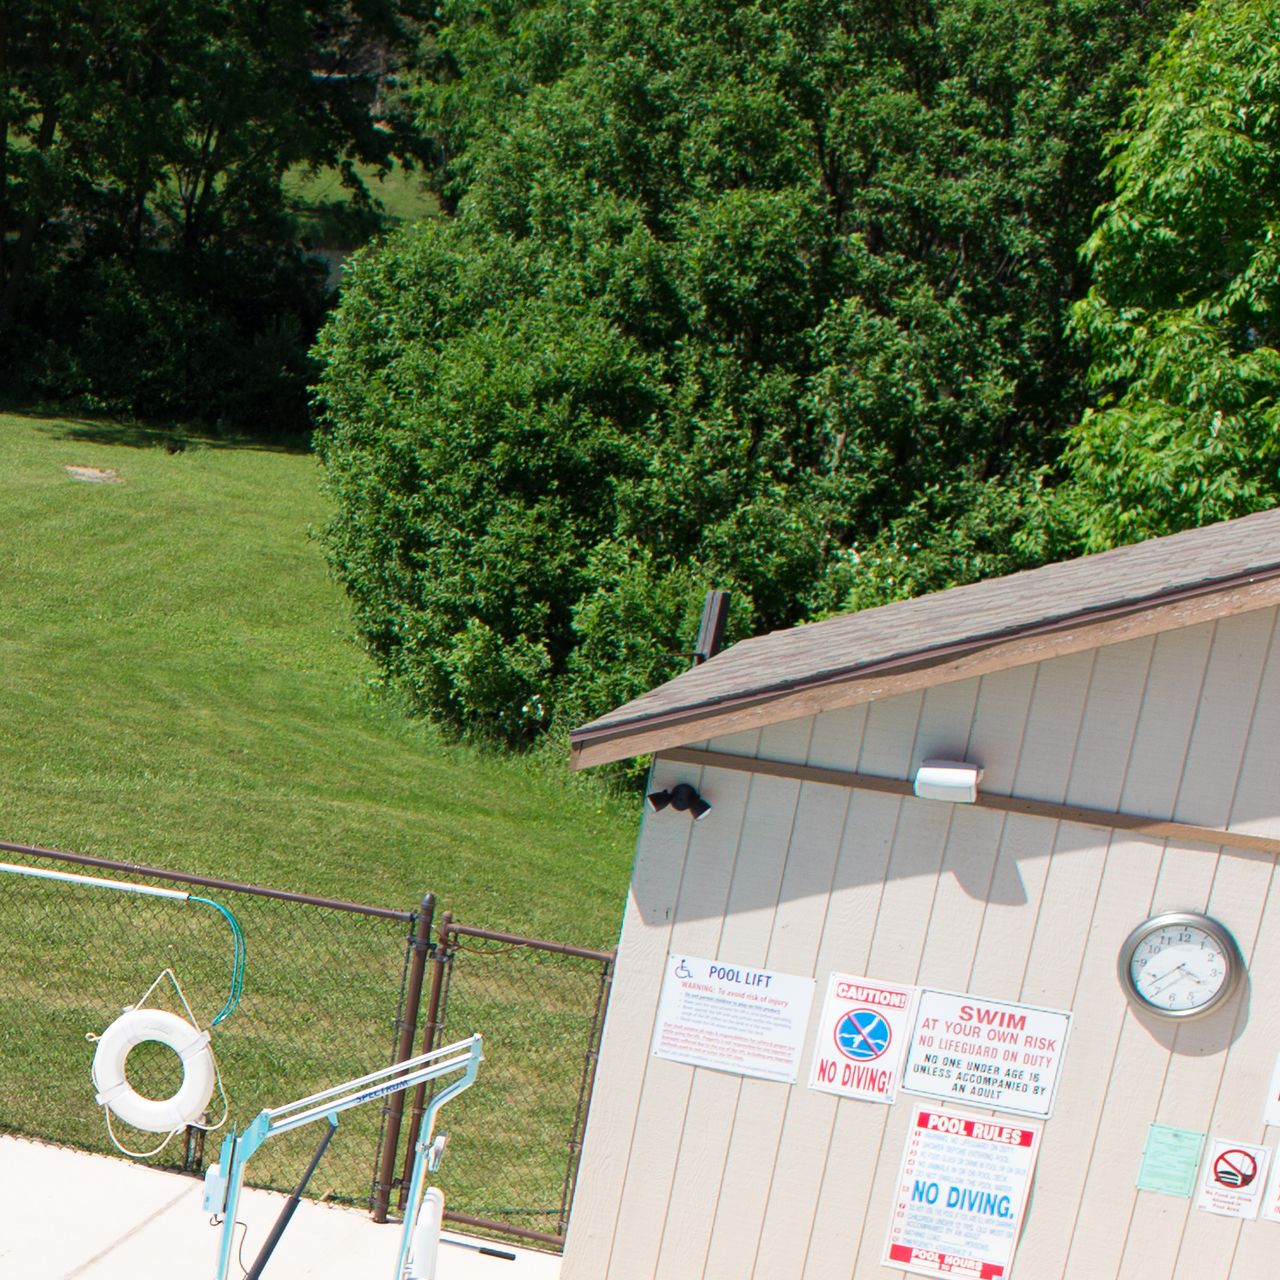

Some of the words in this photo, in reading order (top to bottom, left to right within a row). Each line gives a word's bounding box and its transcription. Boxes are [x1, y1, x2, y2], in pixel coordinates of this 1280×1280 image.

[1160, 936, 1172, 945] 11
[1178, 933, 1191, 942] 12
[1148, 945, 1161, 954] 10
[1208, 953, 1214, 961] 2
[1140, 959, 1147, 967] 9
[1210, 968, 1217, 977] 3
[708, 965, 742, 983] POOL
[745, 971, 773, 988] LIFT
[717, 986, 726, 996] To
[726, 989, 744, 1000] avoid
[745, 991, 758, 1002] risk
[759, 994, 768, 1003] of
[837, 983, 907, 1008] CAUTION!
[1169, 993, 1176, 1001] 6
[959, 1005, 1027, 1031] SWIM
[922, 1017, 939, 1031] AT
[944, 1020, 981, 1039] YOUR
[987, 1028, 1018, 1046] OWN
[1024, 1035, 1056, 1052] RISK
[919, 1035, 934, 1048] NO
[938, 1038, 998, 1059] LIFEGUARD
[1003, 1049, 1017, 1062] ON
[1023, 1053, 1052, 1069] DUTY
[817, 1059, 836, 1083] NO
[841, 1063, 892, 1095] DIVING!
[924, 1054, 938, 1065] NO
[942, 1056, 962, 1069] ONE
[967, 1060, 1000, 1076] UNDER
[1004, 1067, 1025, 1080] AGE
[913, 1063, 952, 1080] UNLESS
[955, 1070, 1028, 1094] ACCOMPANIED
[1032, 1083, 1046, 1096] BY
[951, 1082, 967, 1094] AN
[970, 1085, 1002, 1100] ADULT
[356, 1080, 409, 1103] SPECTRUM
[928, 1113, 967, 1135] POOL
[971, 1120, 1022, 1145] RULES
[911, 1180, 939, 1205] NO
[946, 1185, 1014, 1219] DIVING.
[910, 1247, 941, 1263] POOL
[943, 1253, 984, 1272] HOURS
